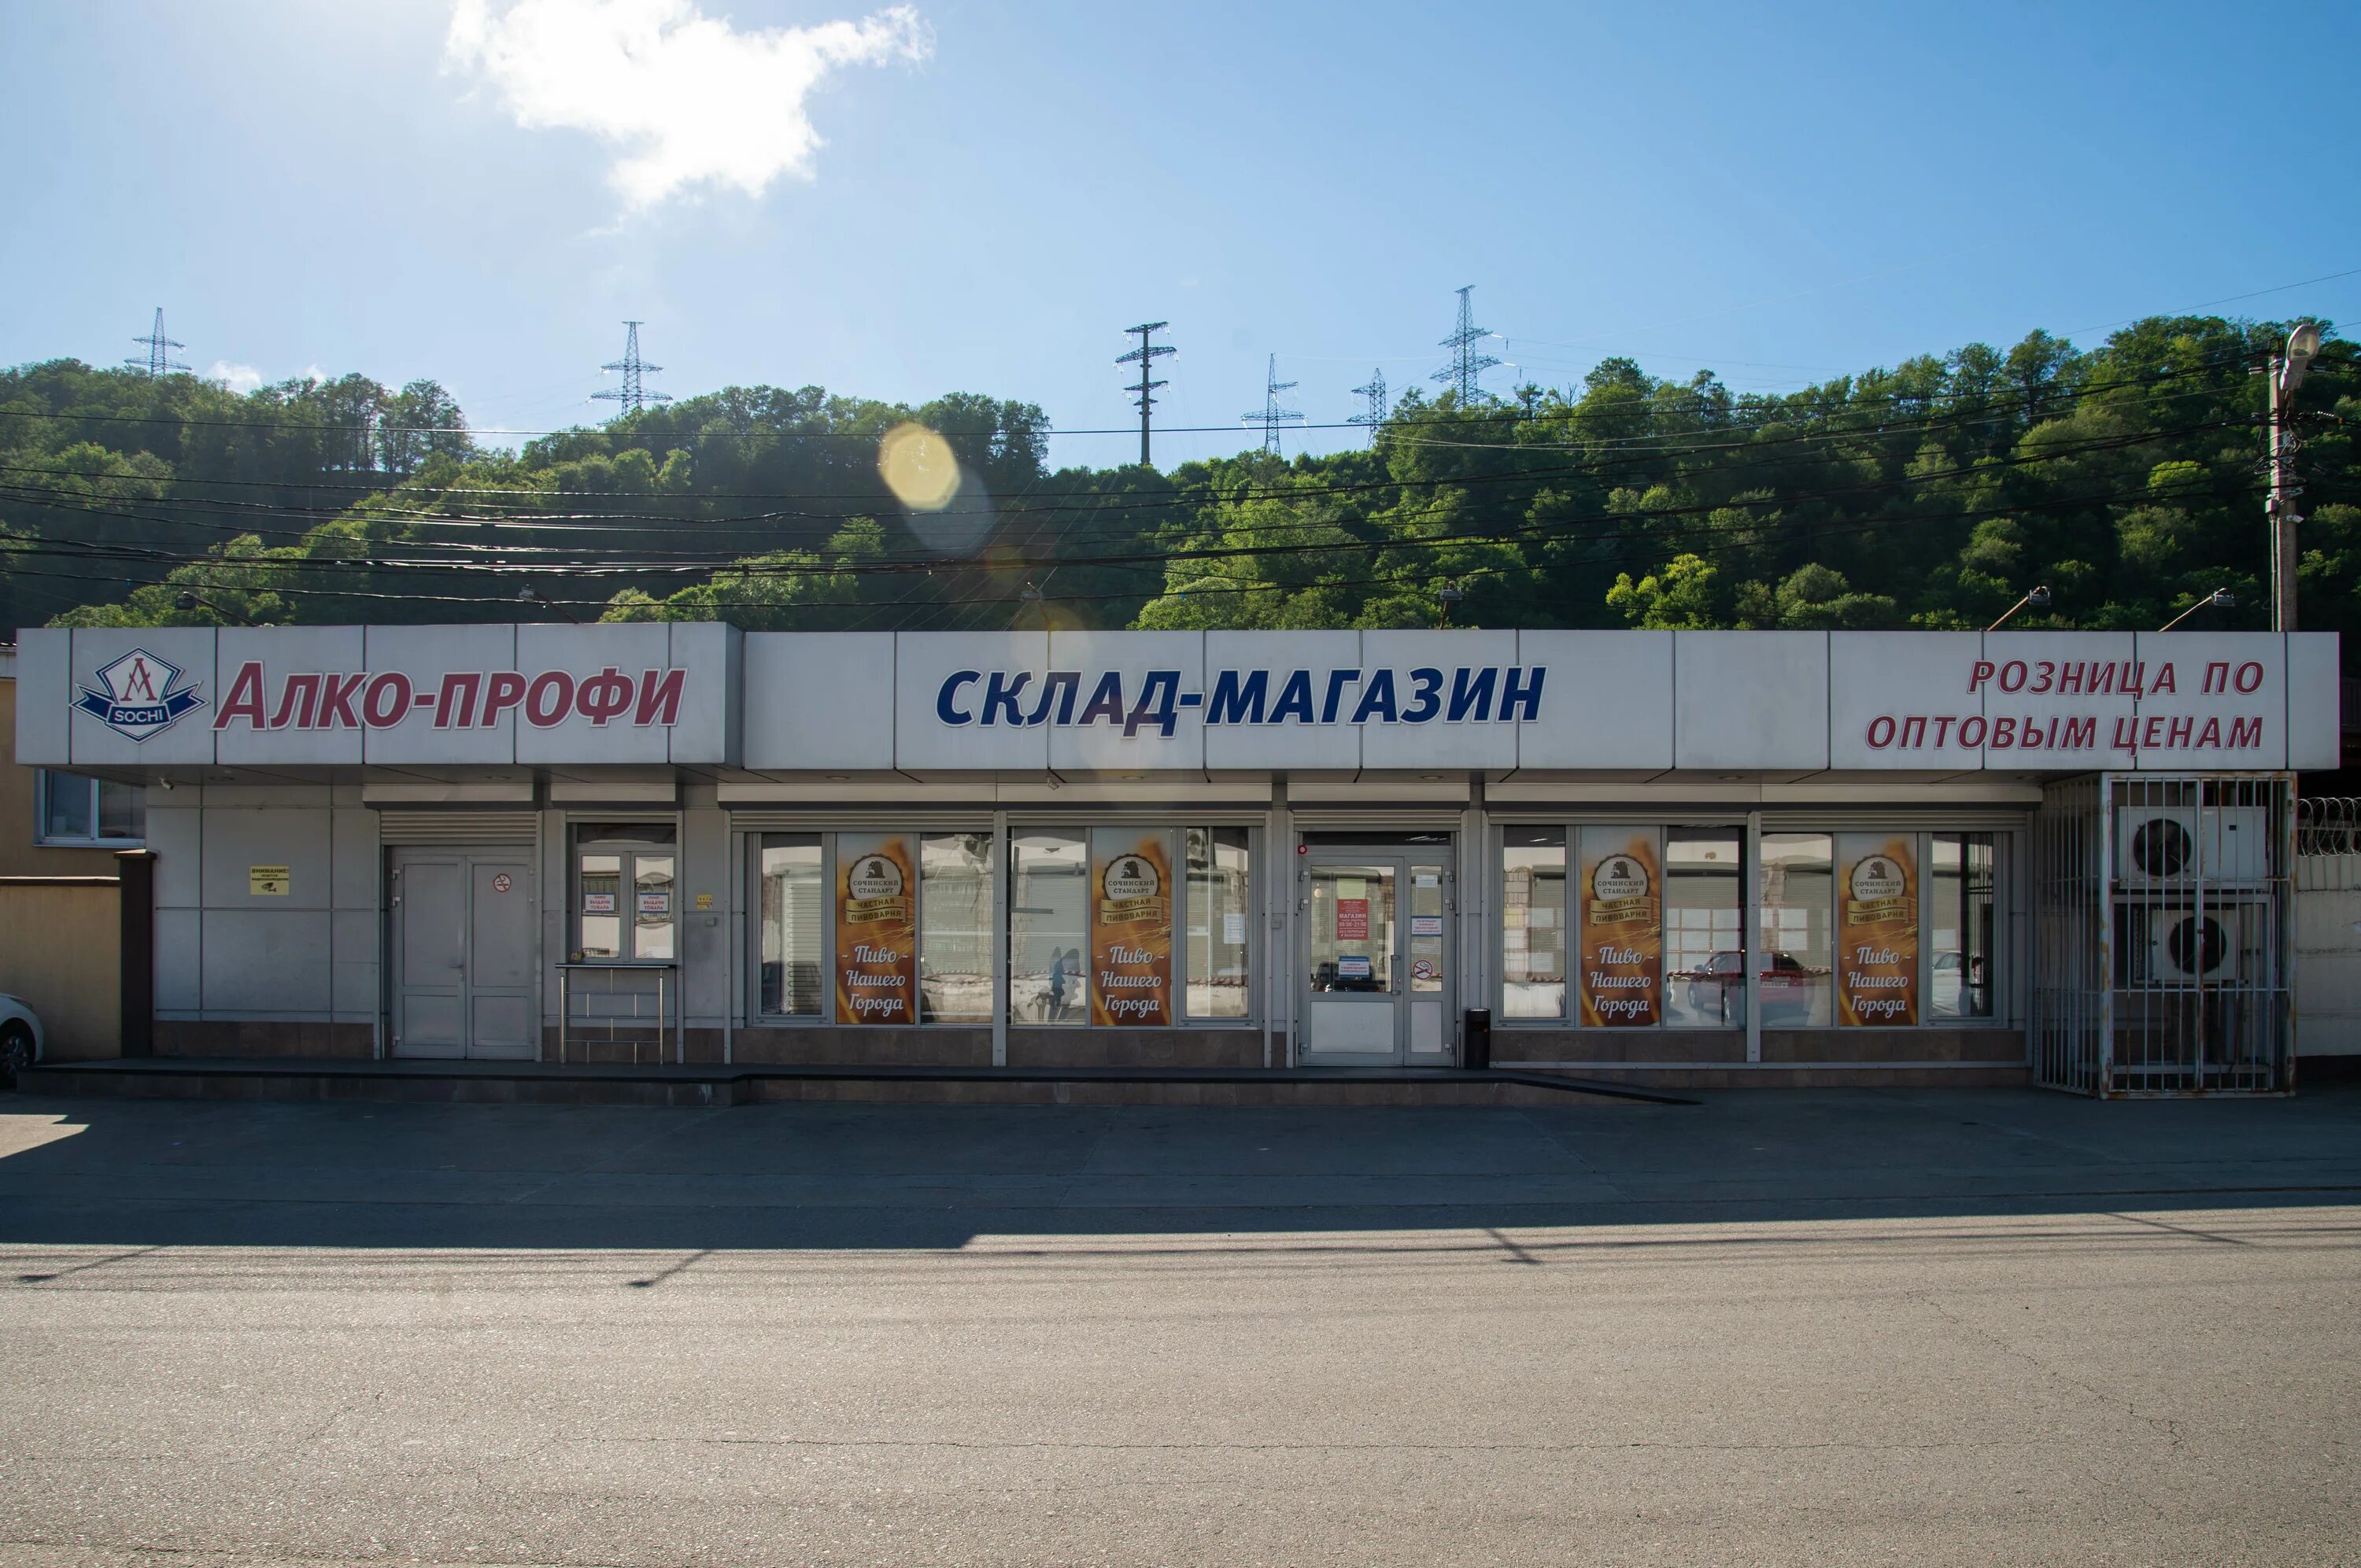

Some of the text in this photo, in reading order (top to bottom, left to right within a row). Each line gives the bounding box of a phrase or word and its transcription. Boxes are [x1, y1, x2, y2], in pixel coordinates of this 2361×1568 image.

[1968, 660, 2264, 702] РОЗНИЦА ПО
[212, 661, 688, 730] АЛКО-ПРОФИ
[936, 665, 1547, 740] СКЛАД-МАГАЗИН
[114, 709, 164, 722] SOCHI
[1865, 714, 2263, 757] ОПТОВЫМ ЦЕНАМ
[857, 898, 896, 909] ЧАСТНАЯ
[1112, 898, 1151, 909] ЧАСТНАЯ
[1602, 898, 1641, 909] ЧАСТНАЯ
[1859, 898, 1897, 909] ЧАСТНАЯ
[851, 910, 902, 921] ПИВОВАРНЯ
[1106, 910, 1158, 922] ПИВОВАРНЯ
[1595, 910, 1647, 922] ПИВОВАРНЯ
[1853, 911, 1905, 923] ПИВОВАРНЯ
[854, 945, 898, 963] Пиво
[1109, 946, 1154, 964] Пиво
[1598, 946, 1643, 965] Пиво
[1856, 946, 1900, 965] Пиво
[845, 969, 907, 987] Нашего
[1100, 970, 1162, 988] Нашего
[1590, 971, 1652, 988] Нашего
[1847, 971, 1908, 988] Нашего
[849, 993, 904, 1017] Города
[1103, 994, 1160, 1019] Города
[1593, 994, 1650, 1019] Города
[1851, 994, 1907, 1019] Города
